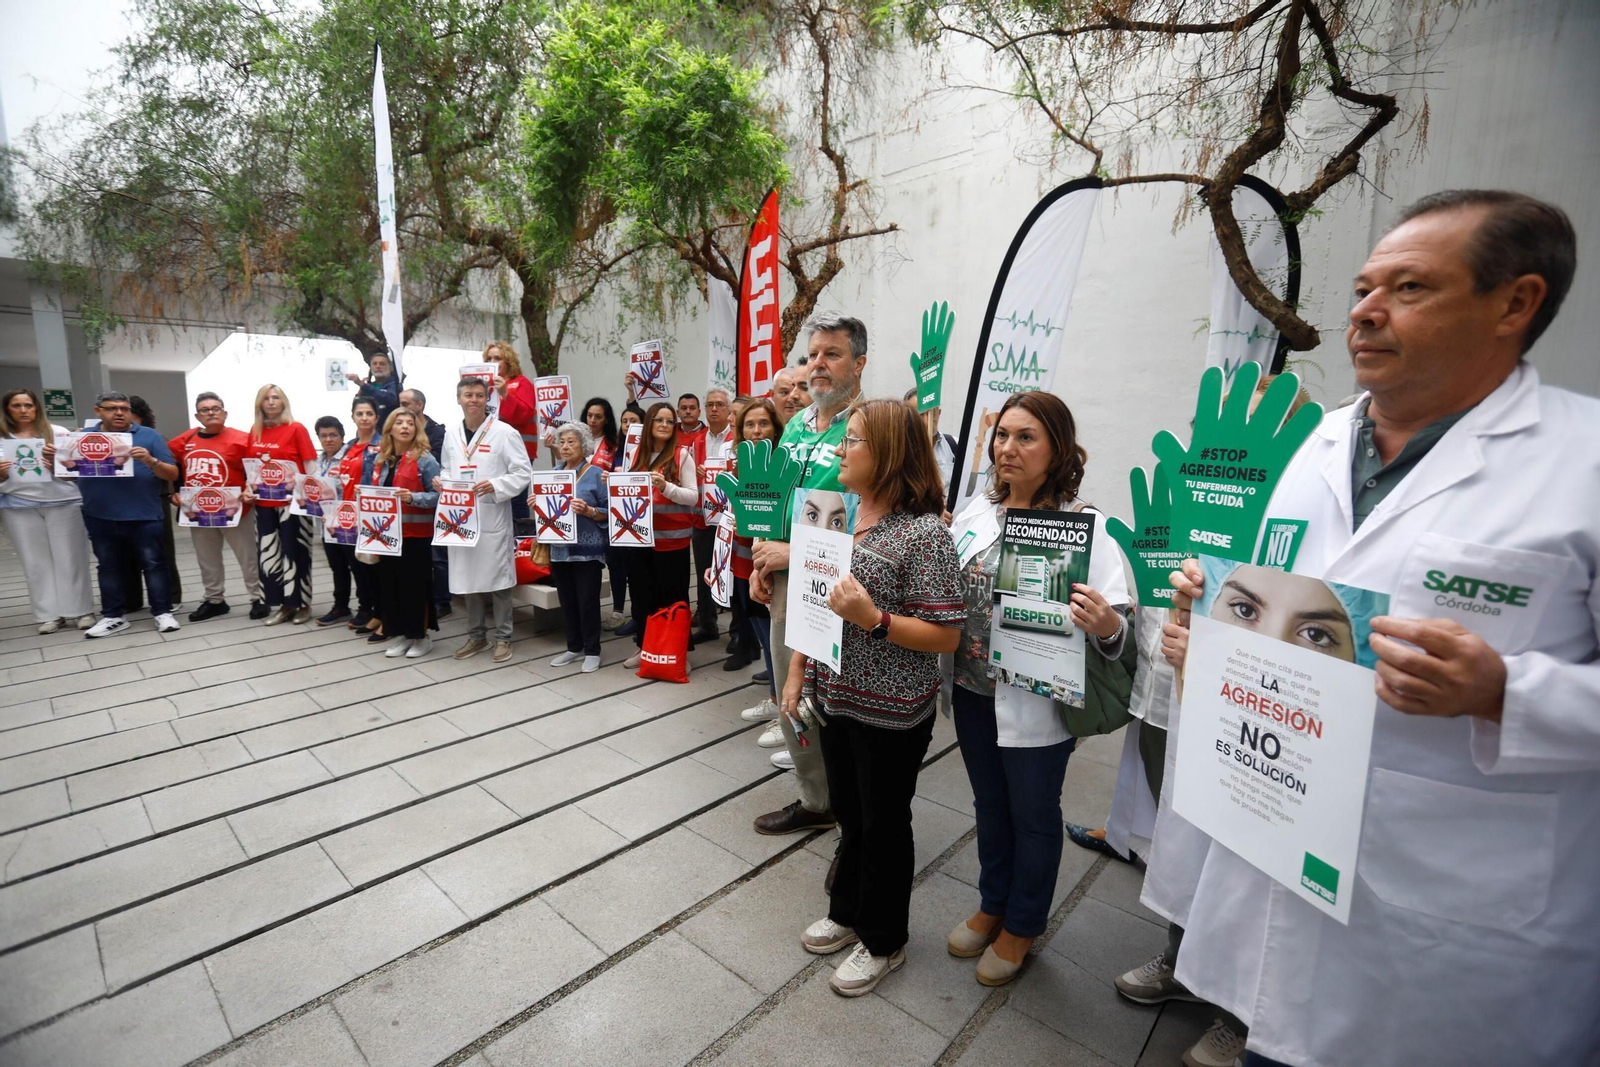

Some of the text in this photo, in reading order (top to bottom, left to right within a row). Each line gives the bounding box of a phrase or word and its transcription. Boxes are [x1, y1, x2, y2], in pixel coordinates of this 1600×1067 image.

[636, 352, 653, 361] STOP
[538, 387, 564, 400] STOP
[82, 443, 109, 452] STOP
[1200, 448, 1248, 462] #STOP
[186, 457, 221, 475] UGT
[262, 469, 282, 477] STOP
[1179, 463, 1267, 482] AGRESIONES
[305, 485, 319, 493] STOP
[541, 484, 565, 494] STOP
[617, 486, 641, 496] STOP
[735, 491, 782, 499] AGRESIONES
[1185, 480, 1256, 495] TU ENFERMERA/O
[199, 497, 222, 505] STOP
[361, 498, 393, 512] STOP
[440, 491, 470, 505] STOP
[1192, 491, 1244, 508] TE CUIDA
[340, 511, 355, 521] STOP
[1013, 515, 1027, 524] ÚNICO
[1028, 518, 1065, 528] MEDICAMENTO
[1066, 521, 1073, 529] DE
[1075, 522, 1089, 530] USO
[747, 524, 771, 532] SATSE
[1005, 524, 1088, 544] RECOMENDADO
[1144, 526, 1171, 536] #STO
[1014, 538, 1033, 546] CUANDO
[1048, 541, 1058, 549] ESTÉ
[1060, 544, 1086, 553] ENFERMO
[1132, 539, 1169, 549] AGRESI
[1189, 529, 1233, 549] SATSE
[818, 550, 826, 559] LA
[1265, 531, 1294, 566] NO
[804, 559, 840, 578] AGRESIÓN
[1146, 560, 1157, 568] TE
[811, 579, 827, 597] NO
[1422, 569, 1534, 608] SATSE
[802, 594, 809, 602] ES
[1434, 594, 1502, 616] Córdoba
[1003, 605, 1064, 627] RESPETO
[1235, 648, 1312, 682] Que me den cita para
[1227, 656, 1249, 669] dentro
[1250, 665, 1258, 673] de
[1290, 680, 1306, 692] que
[1307, 686, 1321, 697] me
[1260, 674, 1280, 694] LA
[1225, 666, 1254, 683] atiendan
[1303, 697, 1319, 709] que
[1220, 682, 1323, 739] AGRESIÓN
[1265, 716, 1275, 725] no
[1240, 722, 1281, 760] NO
[1296, 753, 1313, 765] que
[1215, 739, 1307, 796] ES SOLUCIÓN
[1218, 756, 1302, 806] suficiente personal, que
[1230, 773, 1284, 808] no tenga cama,
[1219, 777, 1295, 825] que hoy no me hagan
[1230, 793, 1241, 805] las
